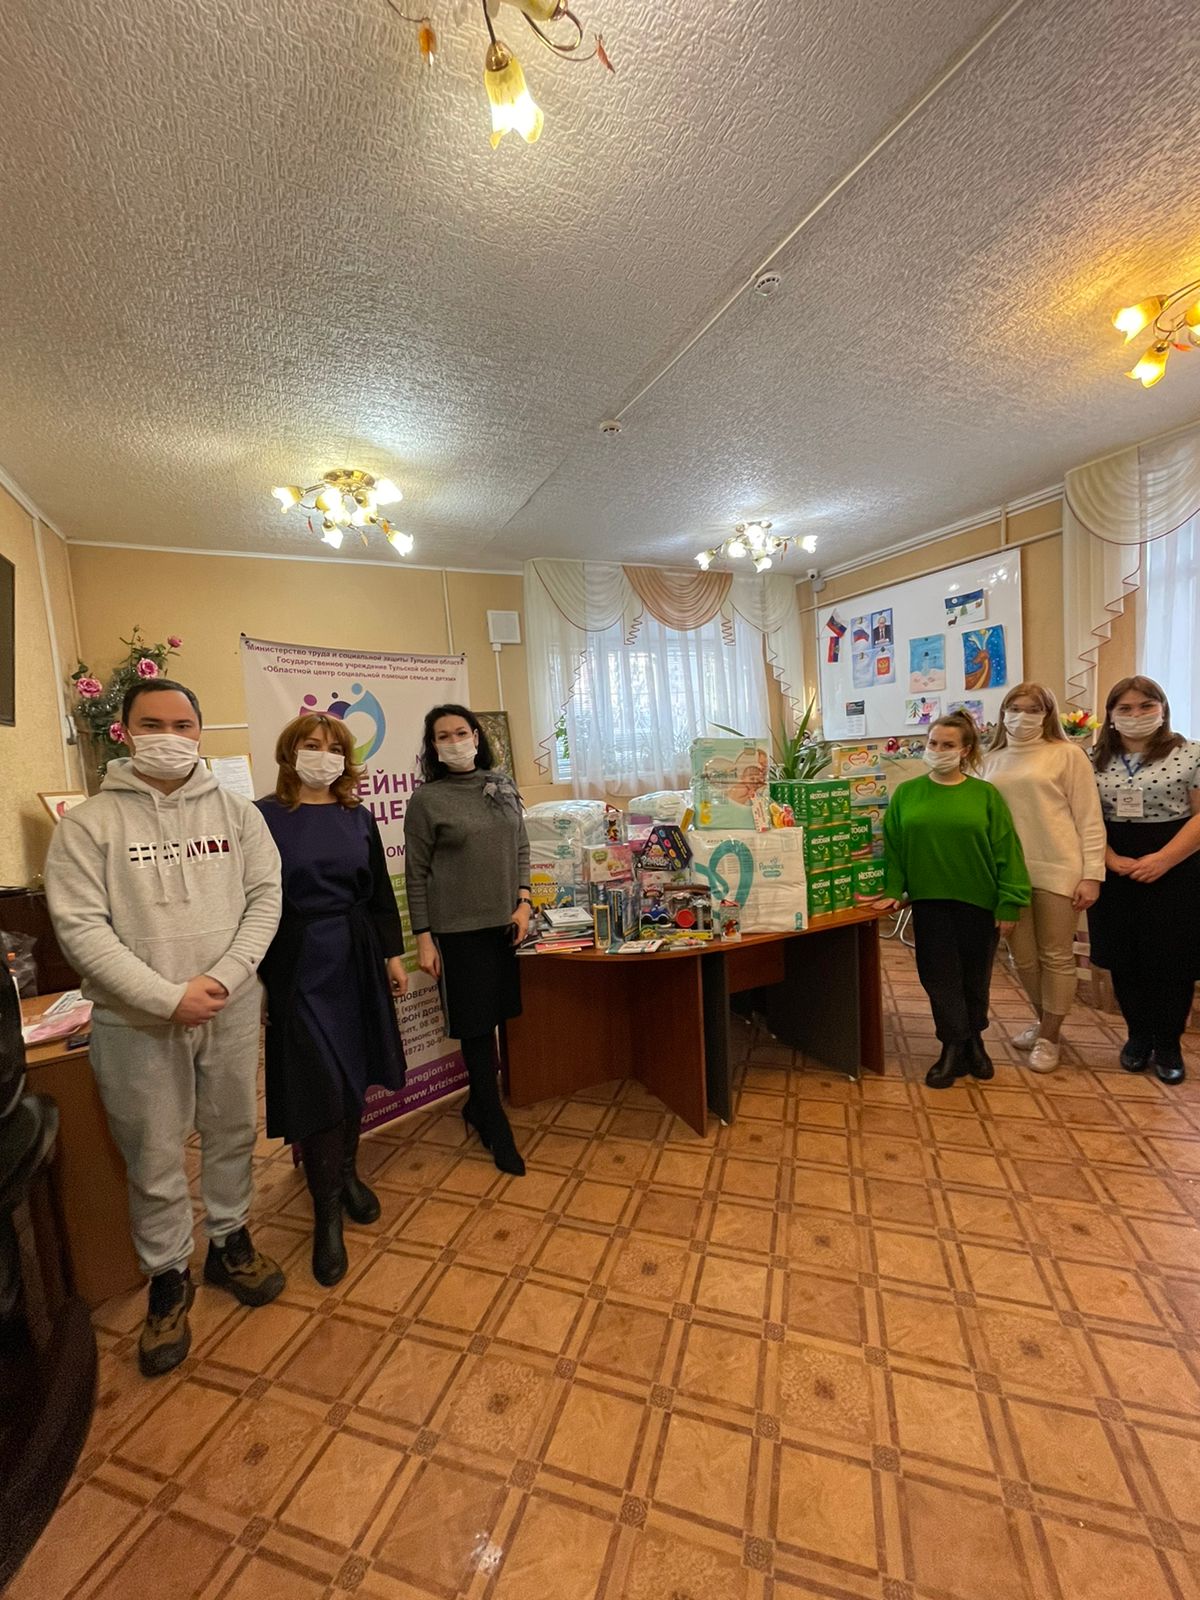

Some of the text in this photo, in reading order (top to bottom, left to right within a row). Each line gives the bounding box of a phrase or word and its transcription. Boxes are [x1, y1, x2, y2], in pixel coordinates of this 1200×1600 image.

[247, 643, 306, 656] Министерство
[308, 650, 330, 658] труда
[338, 653, 382, 661] социальной
[410, 656, 438, 664] Тульской
[276, 656, 343, 667] Государственное
[345, 662, 387, 670] учреждение
[337, 670, 380, 678] социальной
[357, 769, 424, 796] ЕЙН
[810, 791, 829, 799] NESTOGEN
[831, 789, 849, 797] NESTOGEN
[369, 799, 409, 825] ЦЕ
[851, 824, 868, 834] TOGEN
[811, 836, 830, 845] NESTOGEN
[858, 868, 884, 880] NESTOGEN
[532, 886, 565, 895] КРАСКА
[812, 880, 830, 889] NESTOGEN
[402, 996, 438, 1015] (круглосу
[399, 1005, 441, 1025] ФОН ДОВ
[402, 1027, 443, 1046] Демонстра
[403, 1071, 470, 1105] www.kriziscen
